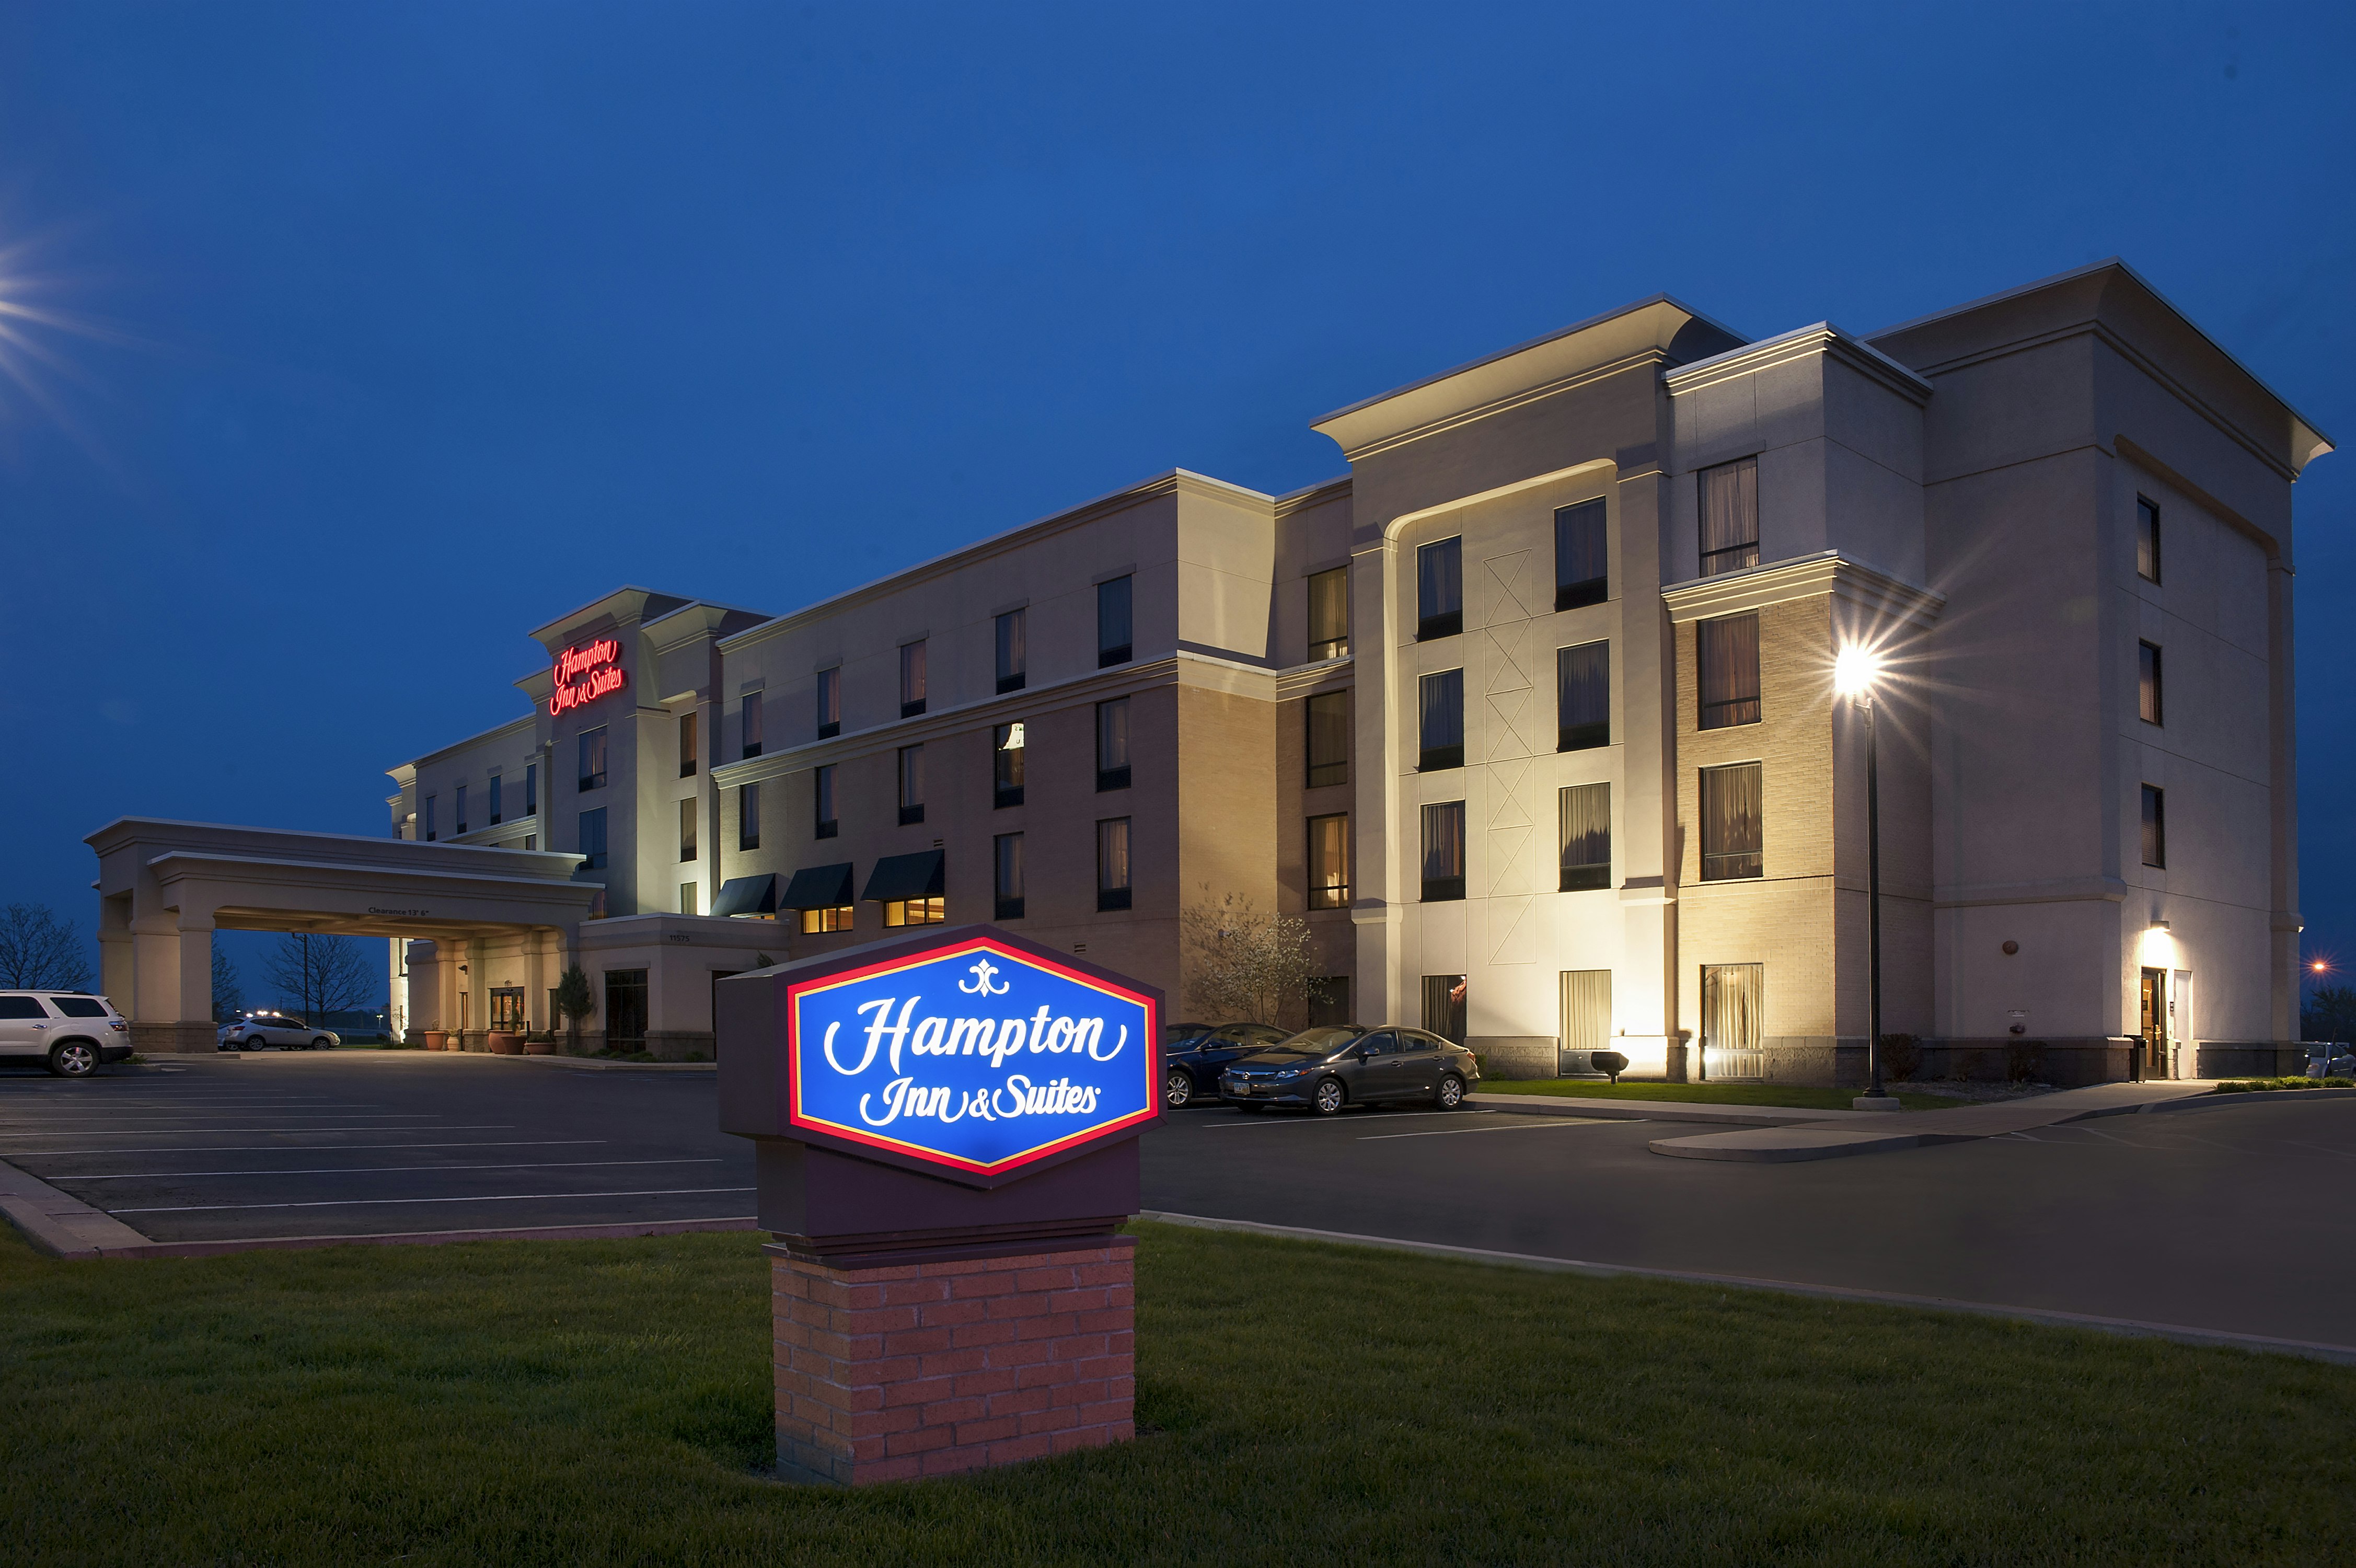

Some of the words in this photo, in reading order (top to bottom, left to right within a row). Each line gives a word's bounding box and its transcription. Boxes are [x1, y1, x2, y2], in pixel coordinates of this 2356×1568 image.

[554, 639, 617, 686] Hampton
[550, 684, 581, 716] Inn
[580, 683, 589, 704] &
[587, 666, 622, 699] Suites
[368, 907, 407, 915] Clearance
[824, 996, 1127, 1075] Hampton
[860, 1077, 969, 1126] Inn
[968, 1088, 997, 1121] &
[992, 1075, 1097, 1118] Suites
